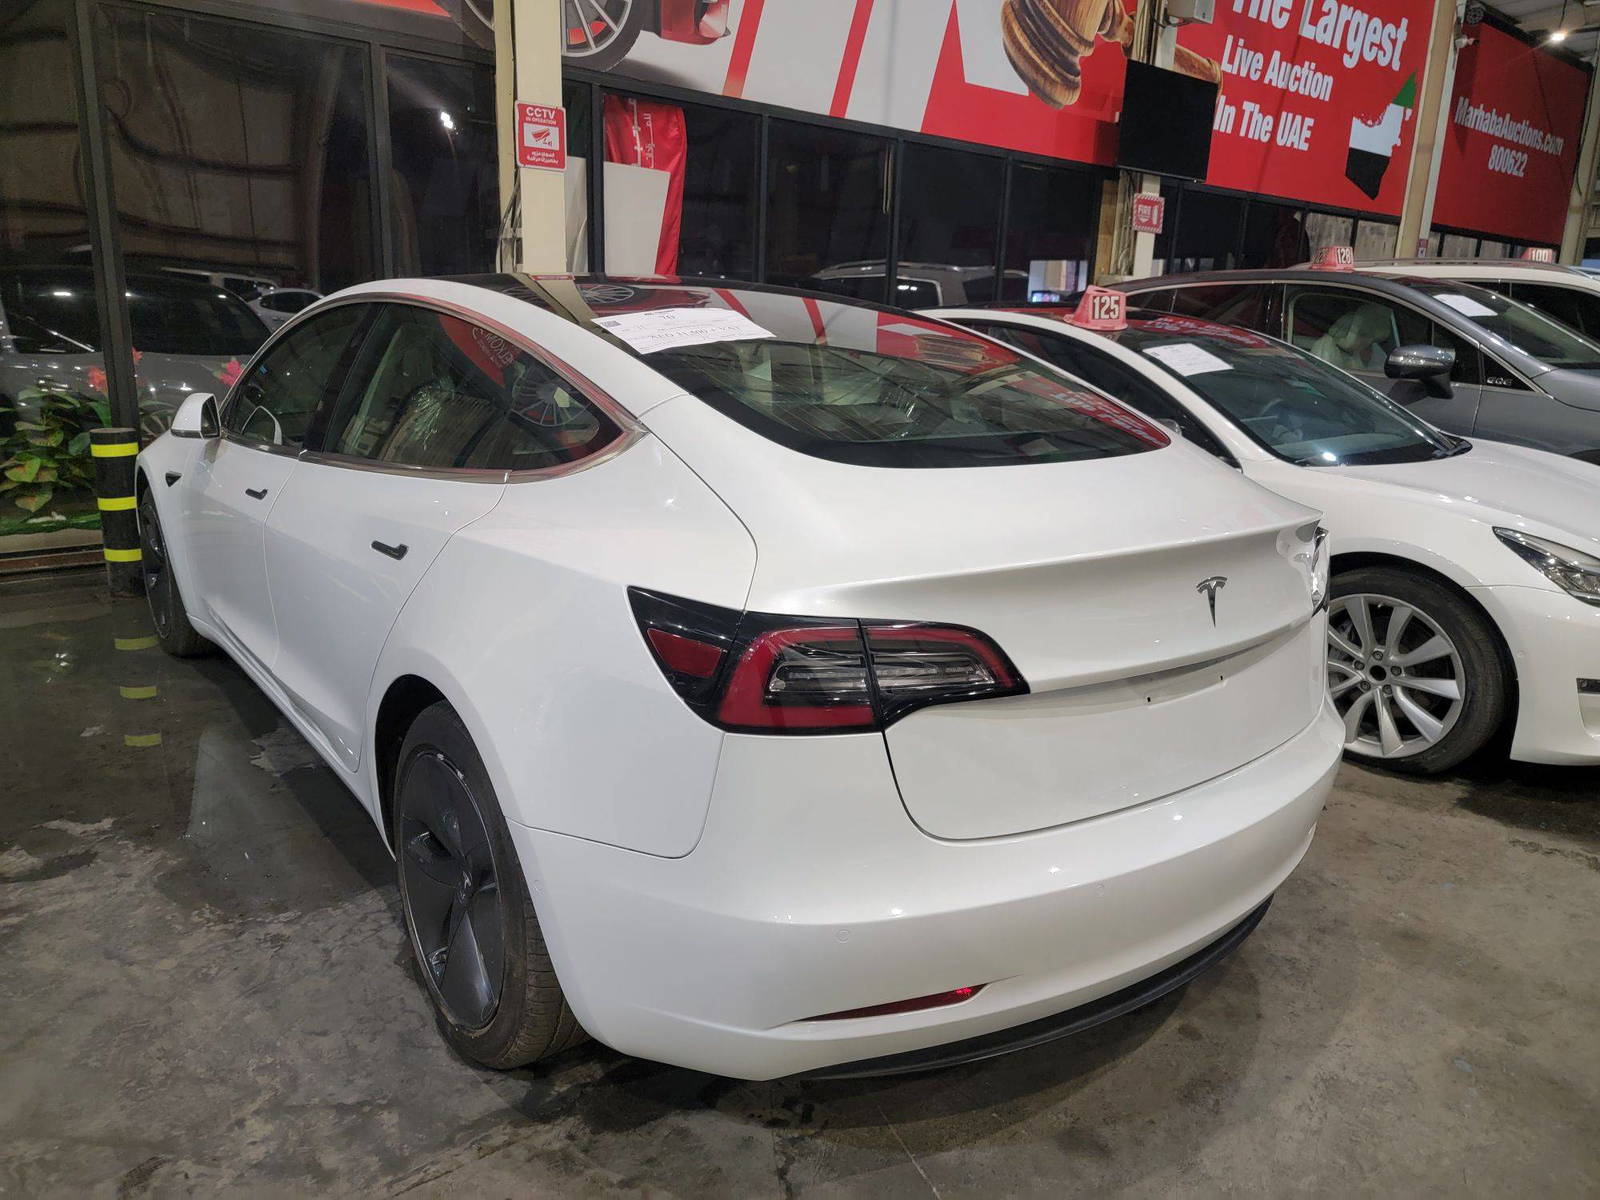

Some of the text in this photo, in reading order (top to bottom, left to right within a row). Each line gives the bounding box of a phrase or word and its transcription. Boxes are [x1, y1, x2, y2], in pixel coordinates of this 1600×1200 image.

[1298, 0, 1408, 72] Largest
[1221, 34, 1334, 102] Live Auction
[526, 106, 555, 119] CCTV
[1213, 94, 1315, 152] In The UAE
[1454, 95, 1564, 156] MarhabaAuctions.com
[1487, 144, 1529, 178] 800622
[1531, 248, 1548, 262] 100
[1092, 295, 1120, 320] 125
